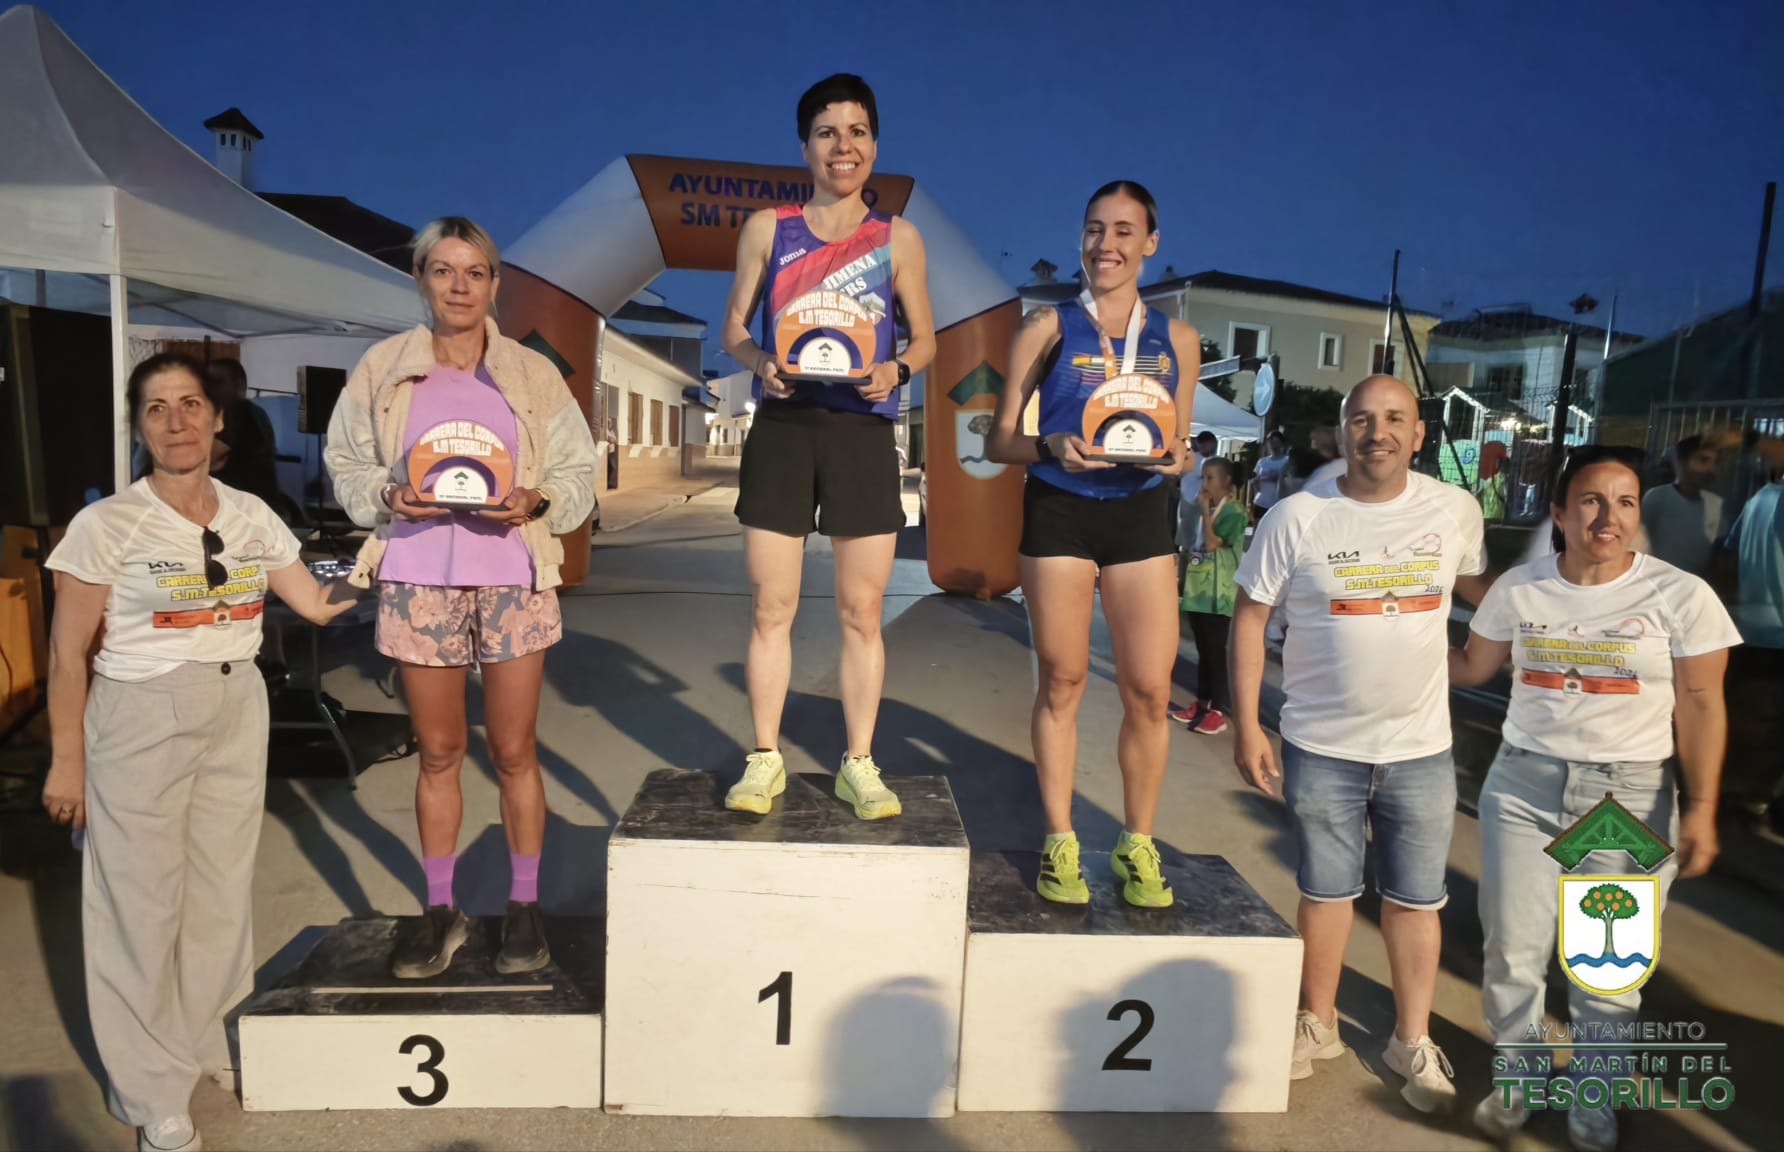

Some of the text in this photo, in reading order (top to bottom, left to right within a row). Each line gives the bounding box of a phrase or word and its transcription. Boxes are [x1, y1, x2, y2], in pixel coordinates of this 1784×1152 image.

[669, 173, 878, 207] AYUNTAMIO
[681, 202, 721, 226] SM
[1400, 560, 1440, 573] CORPUS
[1585, 640, 1637, 654] CORPUS
[758, 971, 793, 1045] 1
[1102, 1000, 1155, 1071] 2
[396, 1035, 449, 1107] 3
